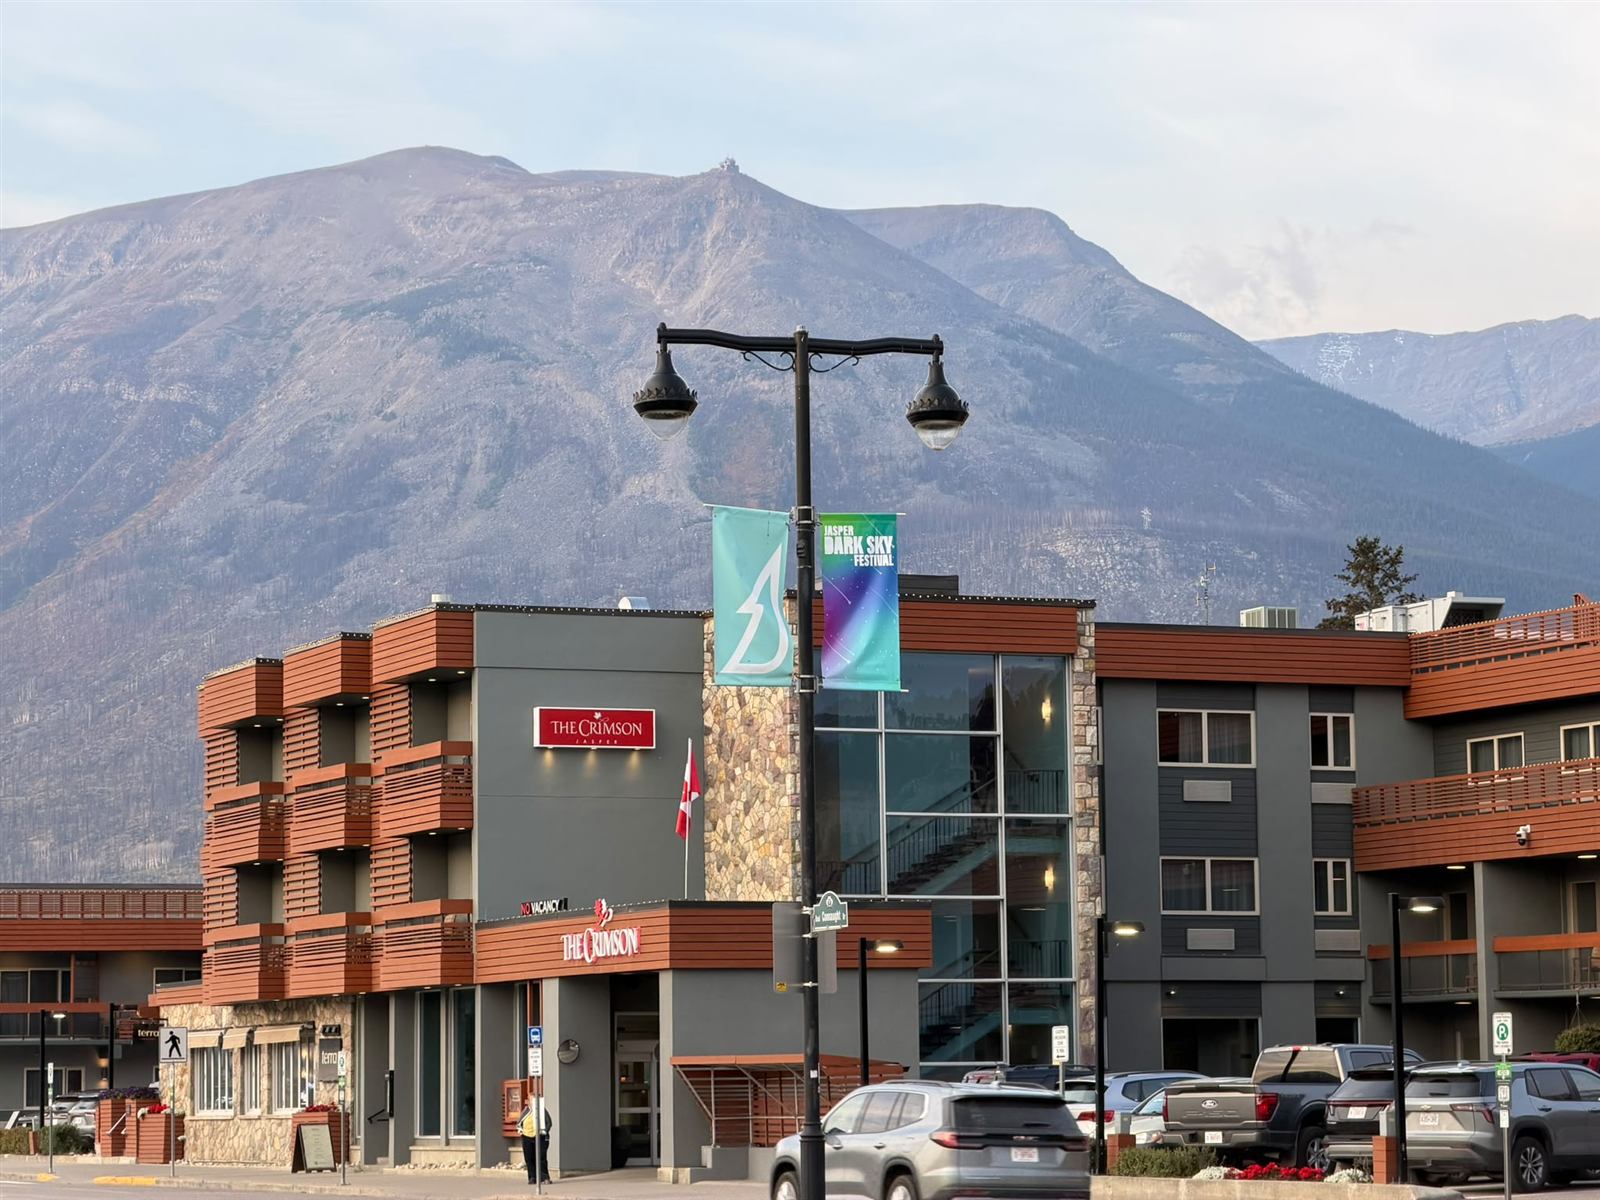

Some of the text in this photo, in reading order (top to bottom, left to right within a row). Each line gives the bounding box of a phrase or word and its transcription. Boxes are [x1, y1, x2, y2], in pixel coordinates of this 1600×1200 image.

[824, 525, 854, 536] JASPER
[824, 535, 893, 555] DARK SKY
[854, 554, 894, 567] FESTIVAL
[550, 719, 642, 737] THE CRIMSON
[521, 899, 560, 915] NO VACANCY
[560, 926, 639, 963] THE CRIMSON
[137, 1029, 160, 1037] terra
[321, 1050, 338, 1065] terra
